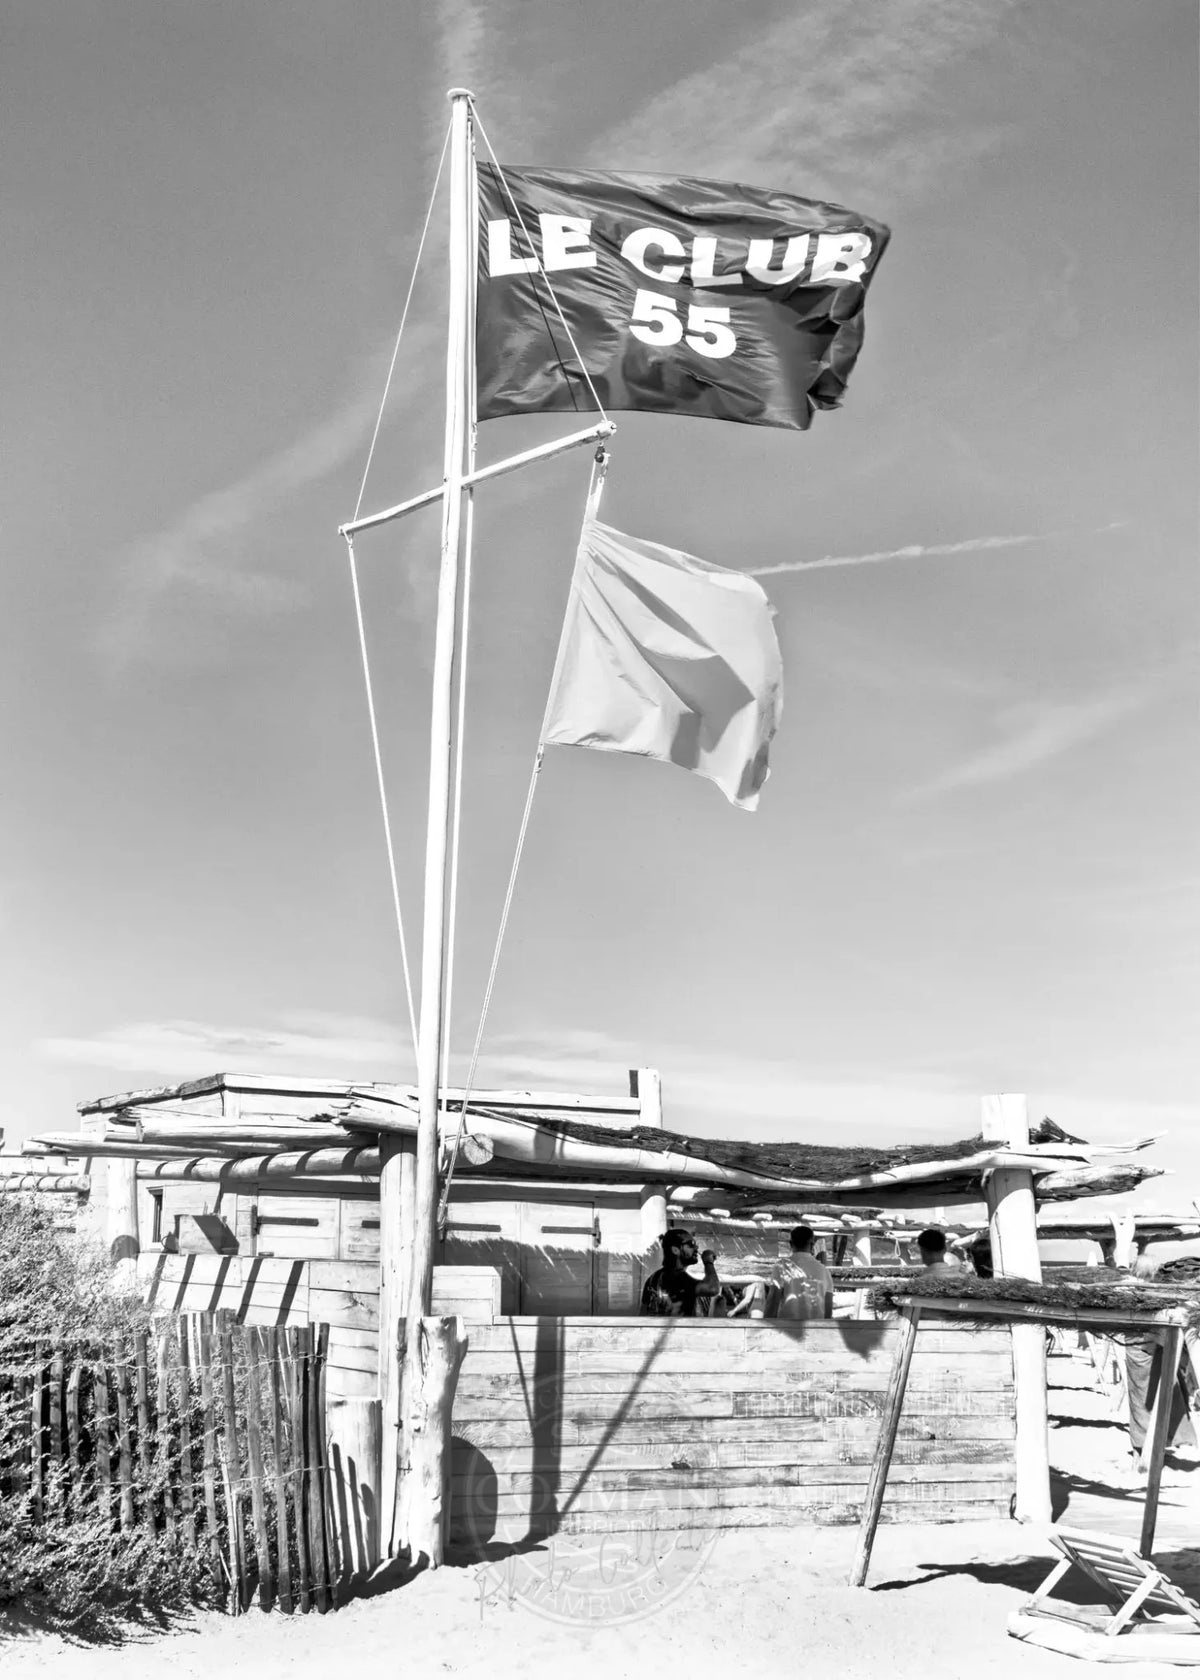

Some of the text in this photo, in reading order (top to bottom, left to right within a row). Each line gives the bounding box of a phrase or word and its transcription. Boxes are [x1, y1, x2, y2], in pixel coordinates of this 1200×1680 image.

[487, 212, 873, 288] LE CLUB
[628, 287, 738, 360] 55
